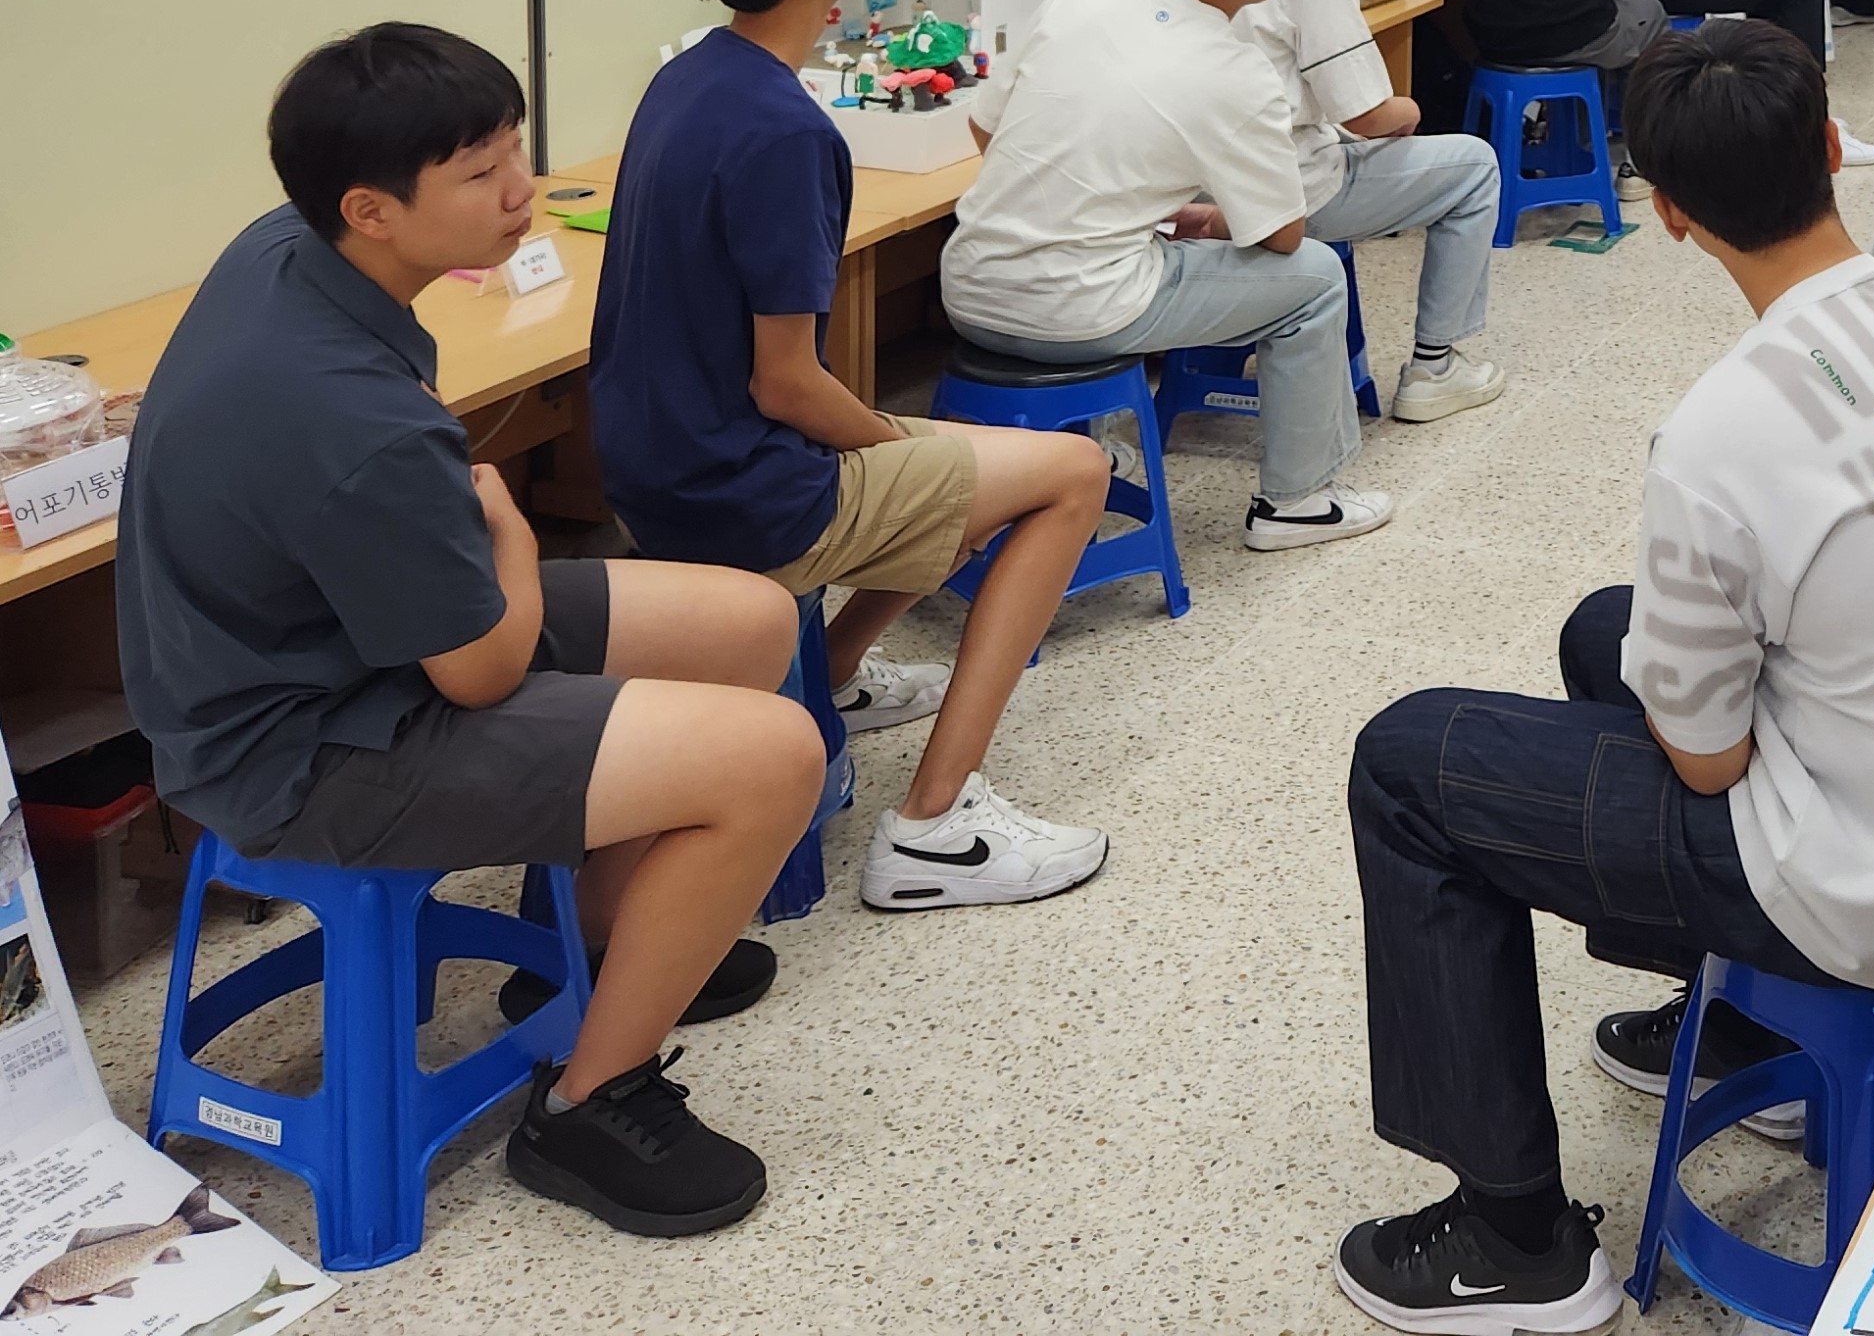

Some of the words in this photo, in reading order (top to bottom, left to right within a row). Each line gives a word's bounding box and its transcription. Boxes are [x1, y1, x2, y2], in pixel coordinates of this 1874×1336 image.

[1809, 346, 1858, 407] Common
[14, 466, 126, 525] 어포기통
[205, 1104, 274, 1138] 경남과학교육원
